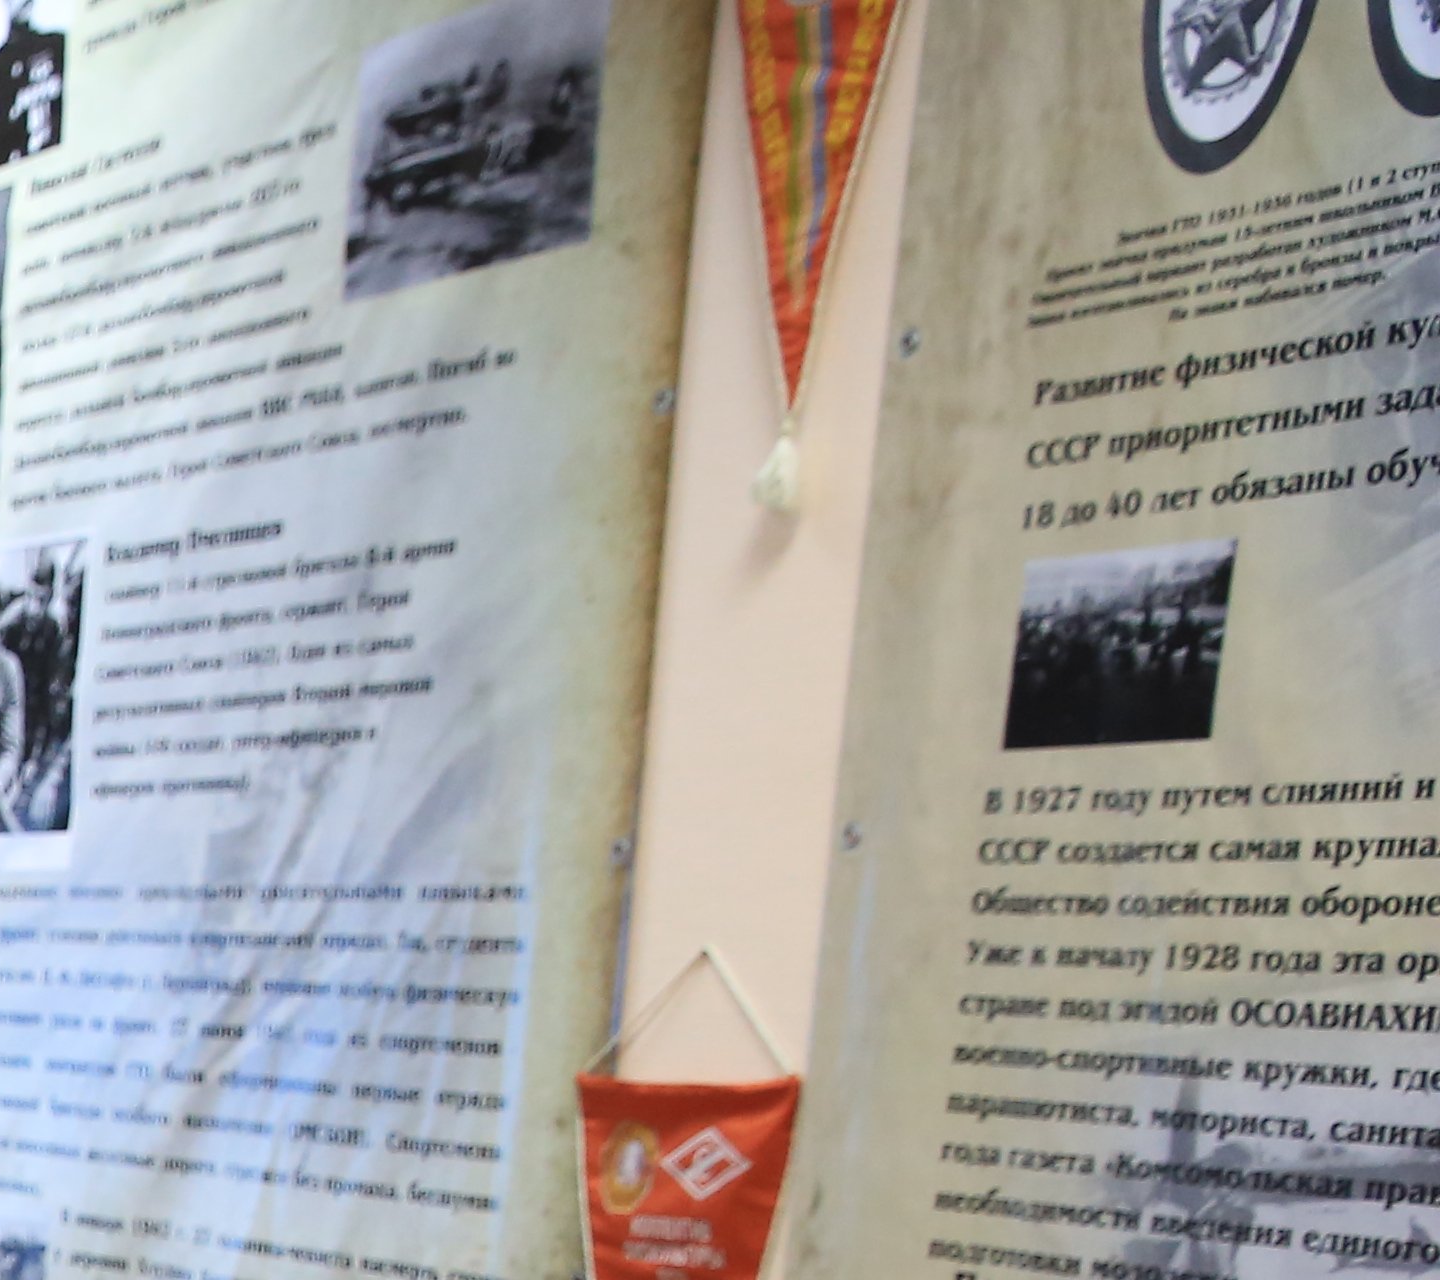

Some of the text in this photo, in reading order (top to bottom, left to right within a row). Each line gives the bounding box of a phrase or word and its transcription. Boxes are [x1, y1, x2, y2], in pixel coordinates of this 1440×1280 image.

[1386, 168, 1397, 185] 2
[1033, 364, 1166, 406] Развитие
[1176, 320, 1375, 388] физической
[1027, 383, 1440, 469] СССР приоритетными зад
[1022, 504, 1055, 531] 18
[1059, 500, 1096, 528] до
[1107, 489, 1142, 516] 40
[1150, 485, 1202, 512] лет
[1211, 465, 1354, 504] обязаны
[985, 773, 1435, 816] В 1927 году путем слияний и
[978, 836, 1440, 868] СССР создается самая крупна
[971, 885, 1440, 923] Общество содействия обороне
[966, 940, 1022, 967] Уже
[1030, 946, 1046, 967] к
[1056, 944, 1153, 975] началу
[1164, 943, 1240, 971] 1928
[1249, 948, 1321, 976] года
[1332, 950, 1385, 973] эта
[959, 993, 1049, 1021] стране
[1058, 998, 1110, 1024] под
[952, 1044, 1233, 1080] военно-спортивные
[1244, 1057, 1377, 1090] кружки,
[1151, 1105, 1315, 1141] моториста,
[940, 1140, 999, 1167] года
[1008, 1148, 1093, 1175] газета
[932, 1187, 1440, 1265] необходимости введения единого
[928, 1238, 1081, 1277] подготовки
